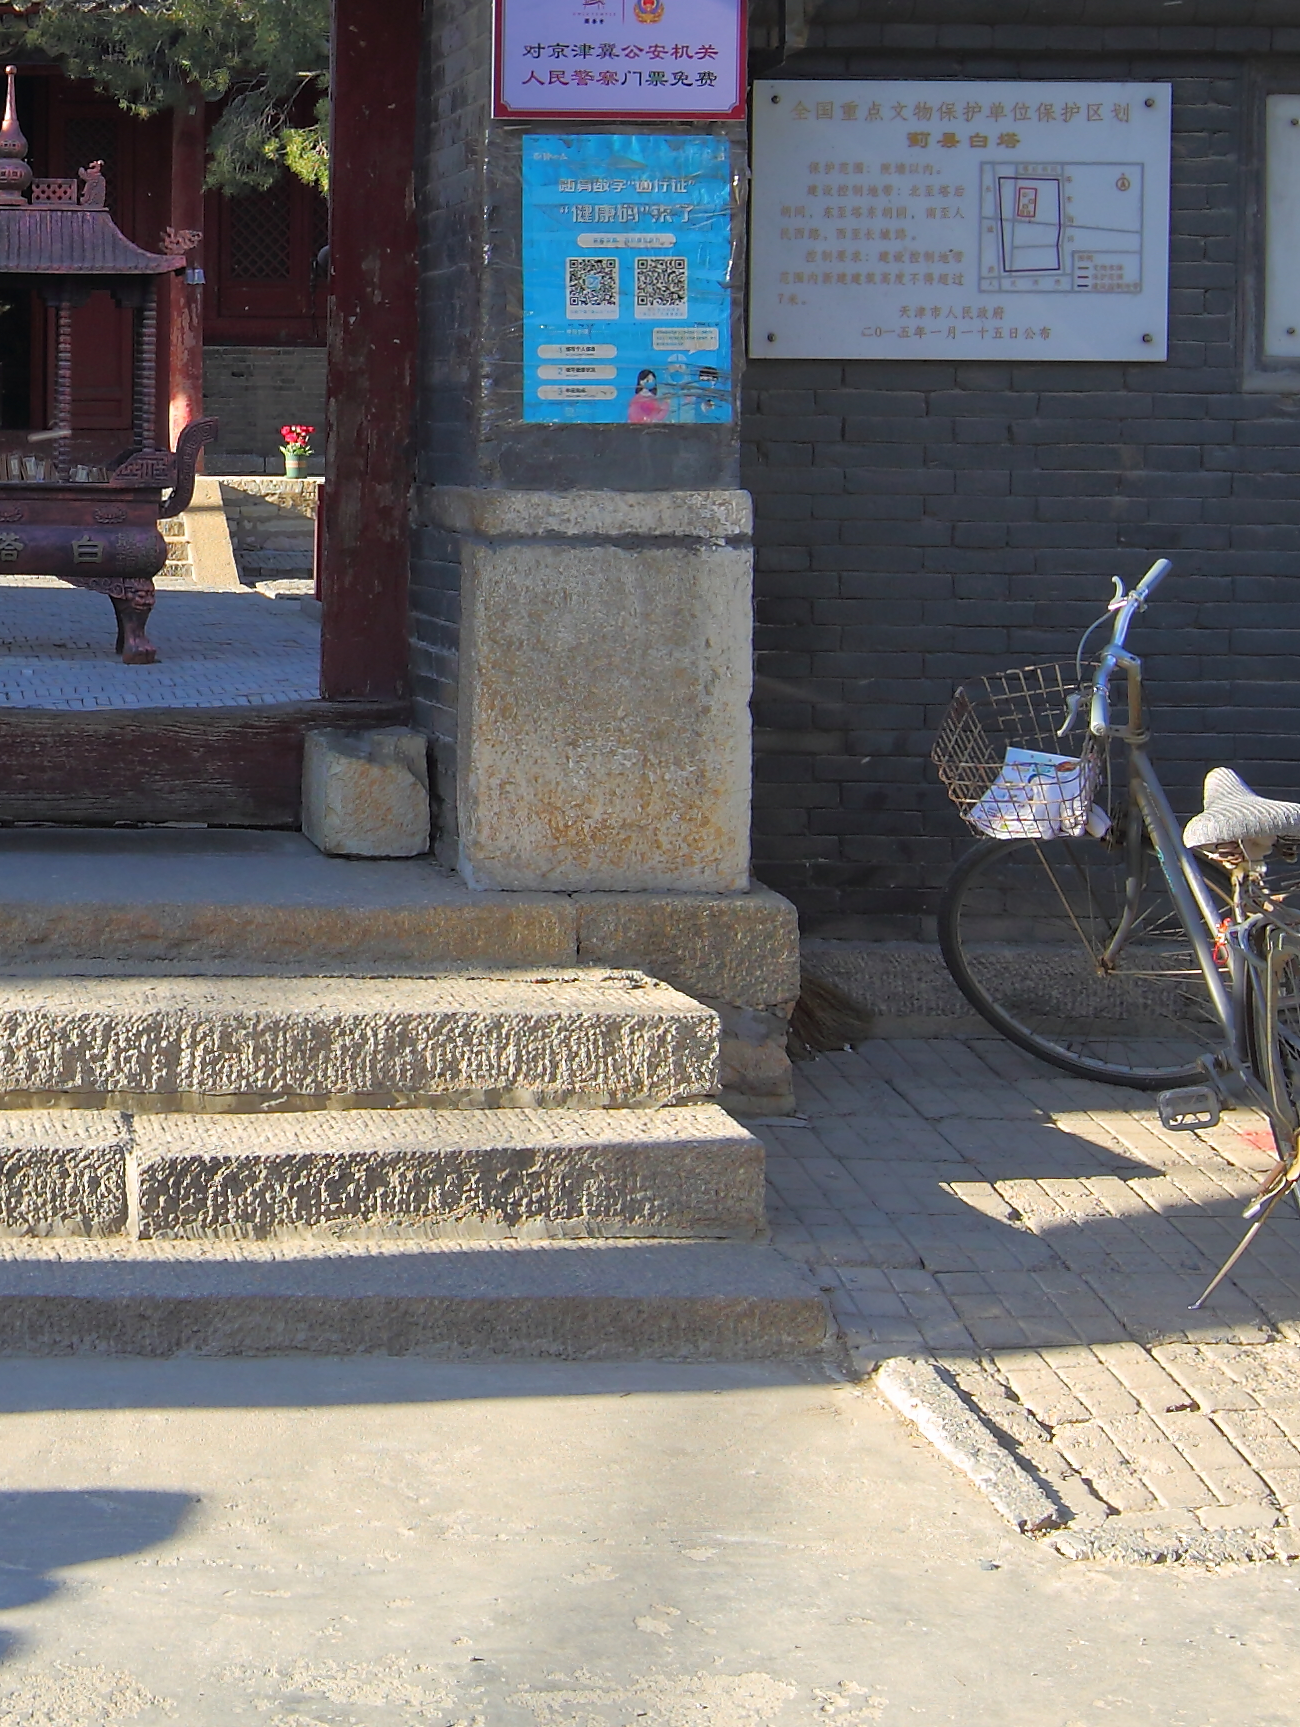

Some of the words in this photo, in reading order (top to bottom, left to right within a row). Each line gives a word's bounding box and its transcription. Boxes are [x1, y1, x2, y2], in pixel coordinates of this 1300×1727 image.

[523, 42, 718, 61] 对京津冀公安机关
[521, 69, 717, 87] 人民警察门票免费
[790, 101, 1131, 123] 全国重点文物保护单位保护区划
[907, 132, 1021, 149] 蓟县白塔
[899, 305, 1005, 321] 天津市人民政府
